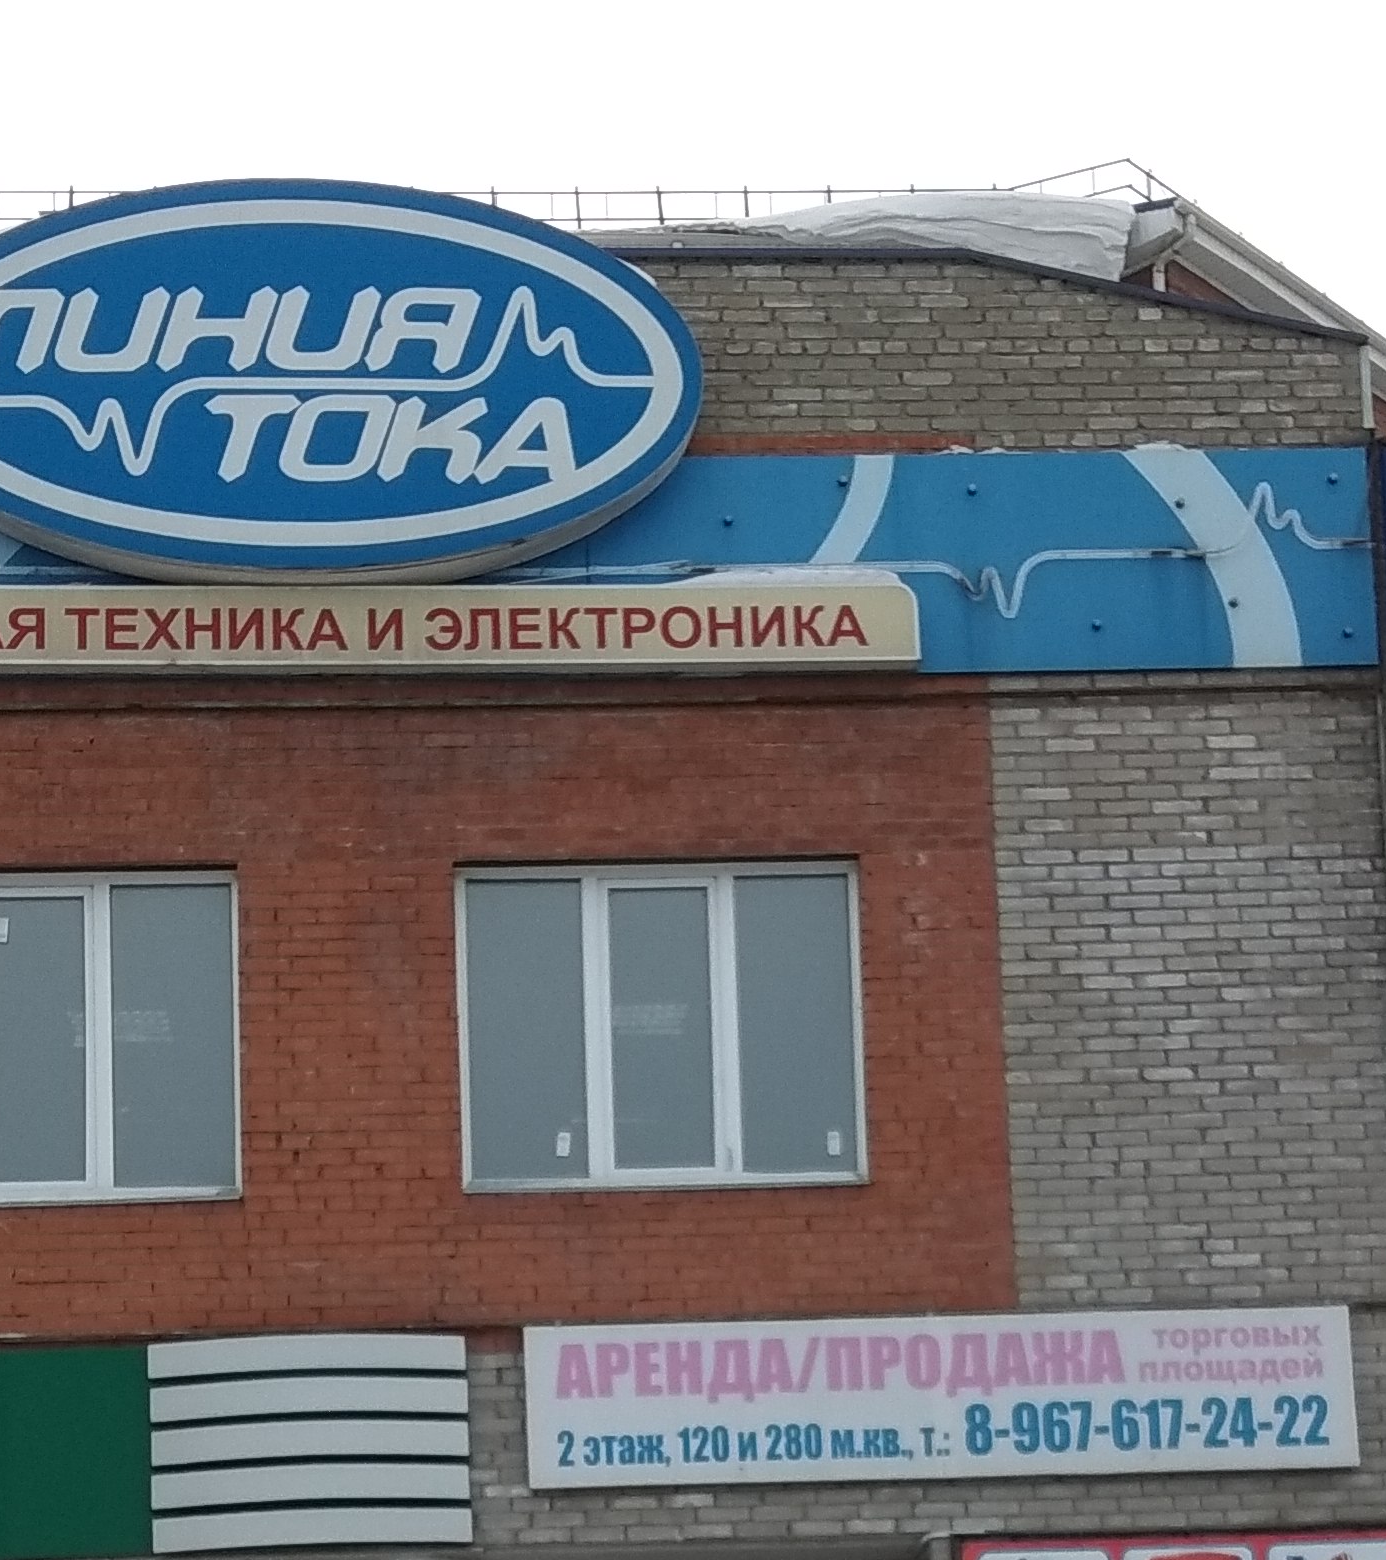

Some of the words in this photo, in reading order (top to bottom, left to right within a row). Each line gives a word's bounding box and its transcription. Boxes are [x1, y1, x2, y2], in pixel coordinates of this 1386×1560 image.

[205, 394, 576, 485] ТОКА
[65, 607, 348, 650] ТЕХНИКА
[368, 608, 403, 650] И
[425, 604, 869, 650] ЭЛЕКТРОНИКА
[556, 1330, 1126, 1403] АРЕНДА/ПРОДАЖА
[1139, 1352, 1325, 1386] площадей
[1151, 1324, 1323, 1356] торговых
[558, 1431, 575, 1466] 2
[583, 1434, 671, 1466] этаж,
[678, 1425, 730, 1464] 120
[738, 1431, 758, 1462] и
[765, 1423, 822, 1461] 280
[830, 1428, 914, 1461] м.кв.,
[964, 1395, 1331, 1456] 8-967-617-24-22
